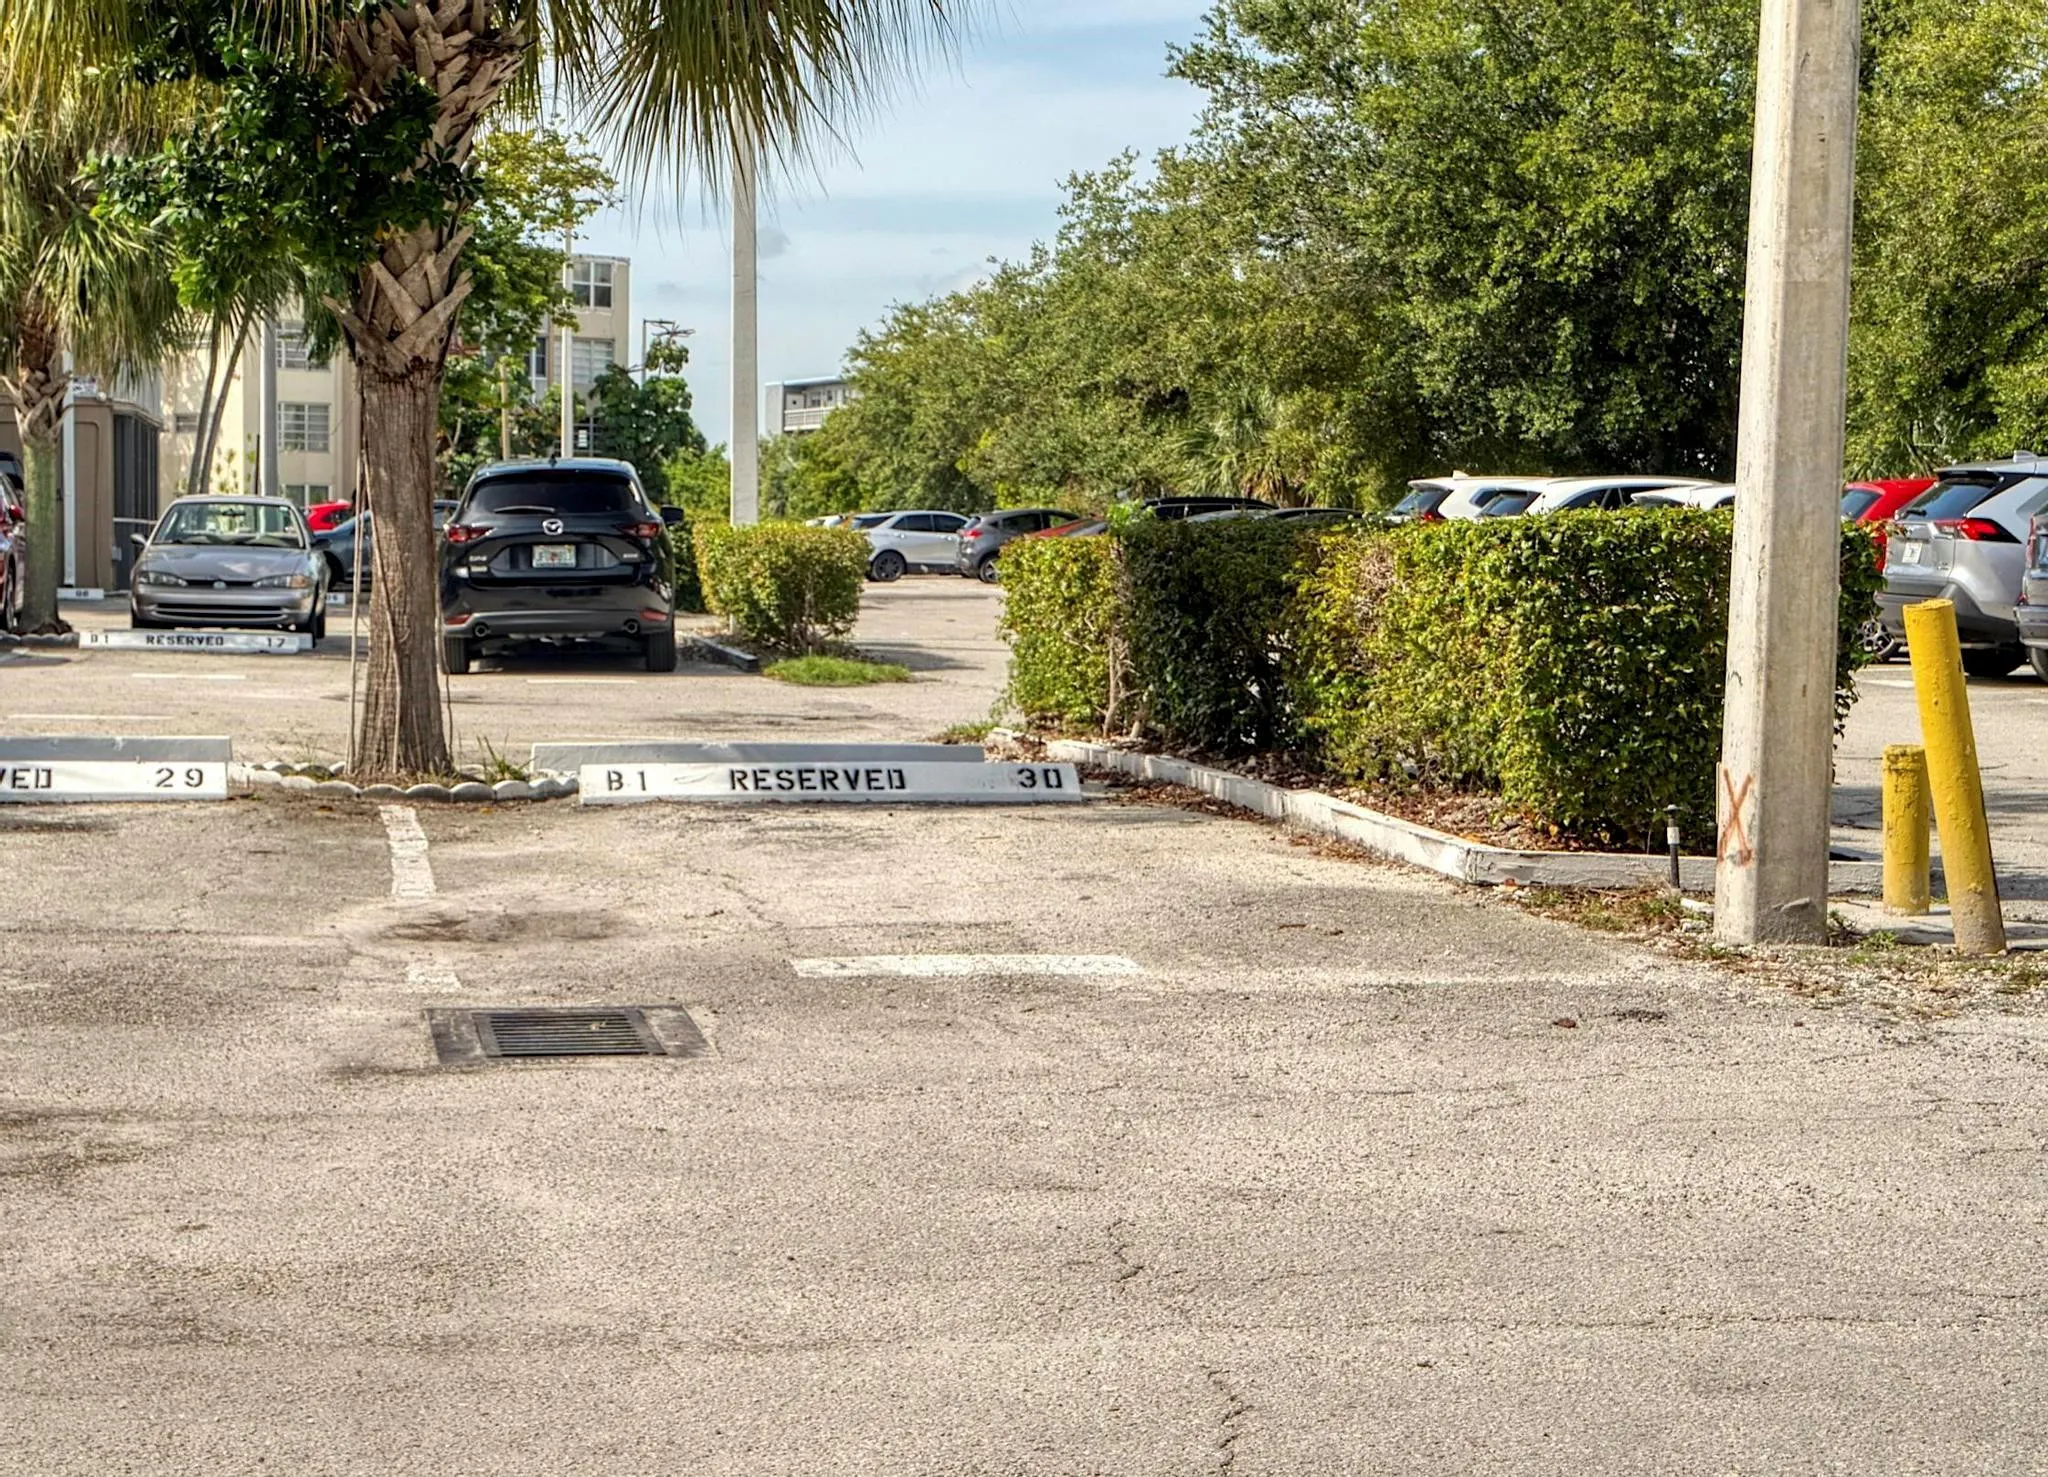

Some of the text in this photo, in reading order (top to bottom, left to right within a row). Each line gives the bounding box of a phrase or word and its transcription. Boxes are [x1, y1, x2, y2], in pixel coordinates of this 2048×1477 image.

[145, 634, 224, 646] RESERVED
[267, 636, 285, 648] 17
[155, 768, 204, 788] 29
[730, 769, 906, 790] RESERVED
[1017, 768, 1062, 789] 30
